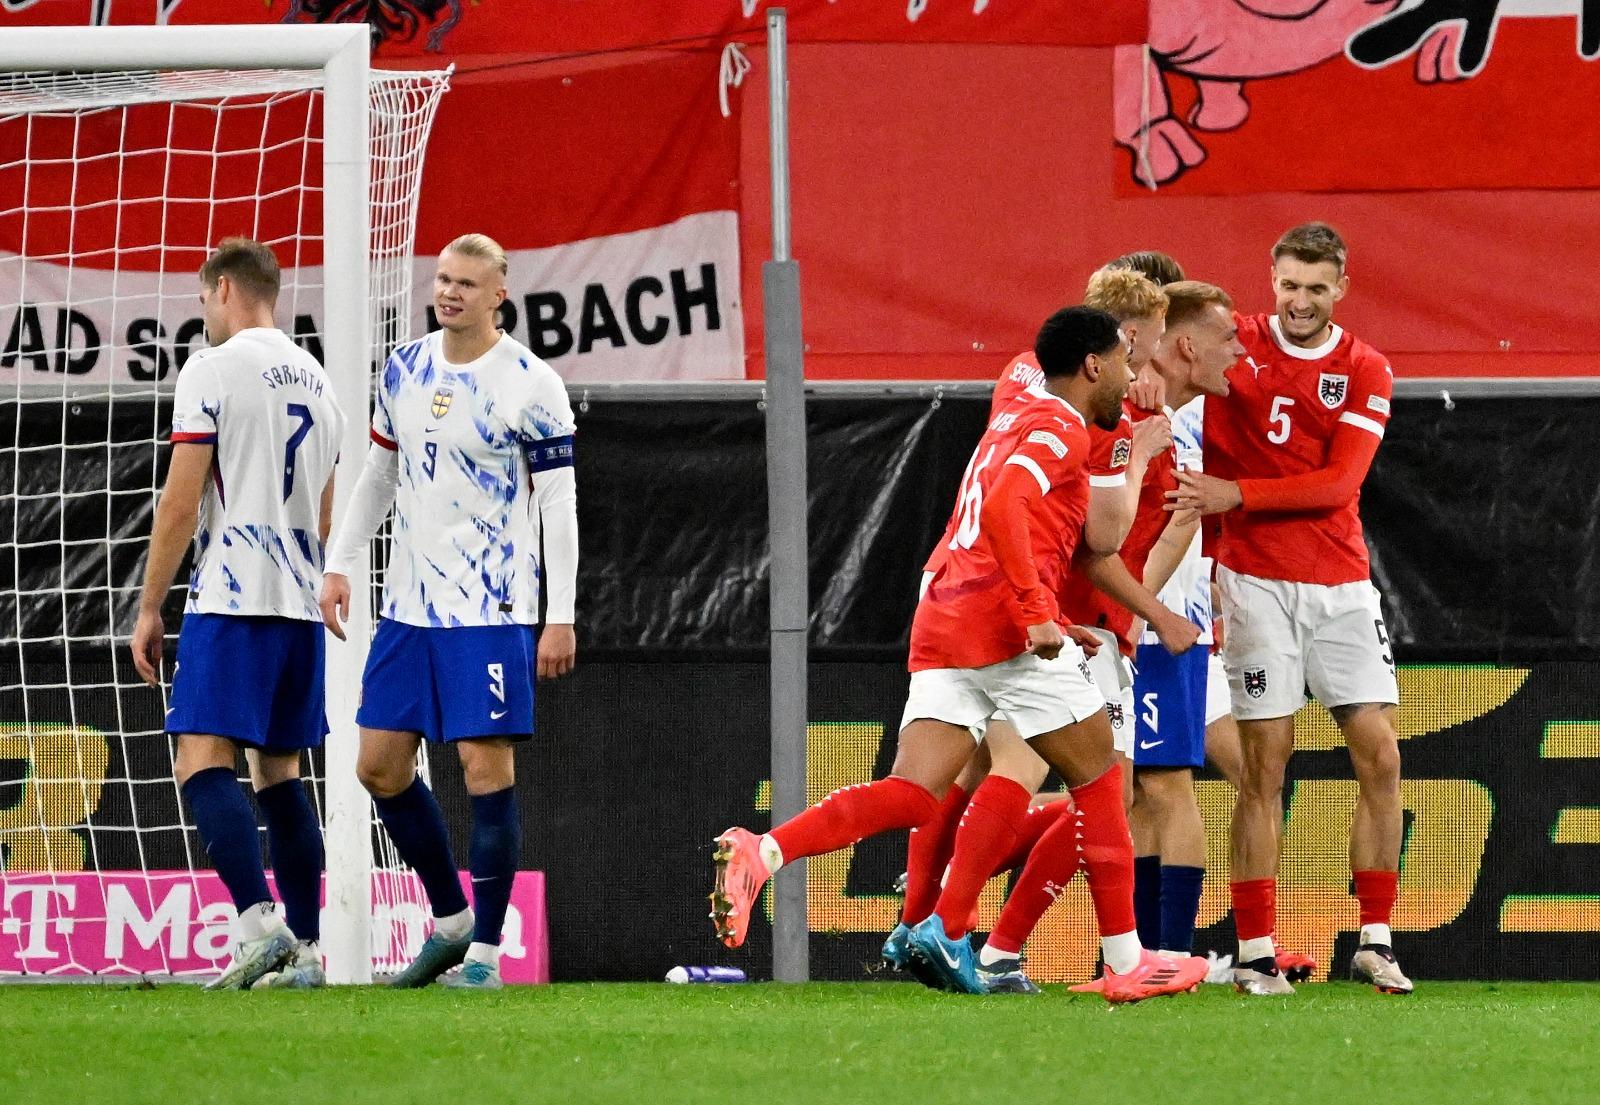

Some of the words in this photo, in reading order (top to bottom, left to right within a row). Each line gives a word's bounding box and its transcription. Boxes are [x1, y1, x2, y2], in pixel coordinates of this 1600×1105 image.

[1267, 395, 1296, 445] 5
[282, 402, 315, 505] 7
[421, 441, 437, 482] 9
[1373, 618, 1394, 666] 5
[487, 662, 505, 704] 9
